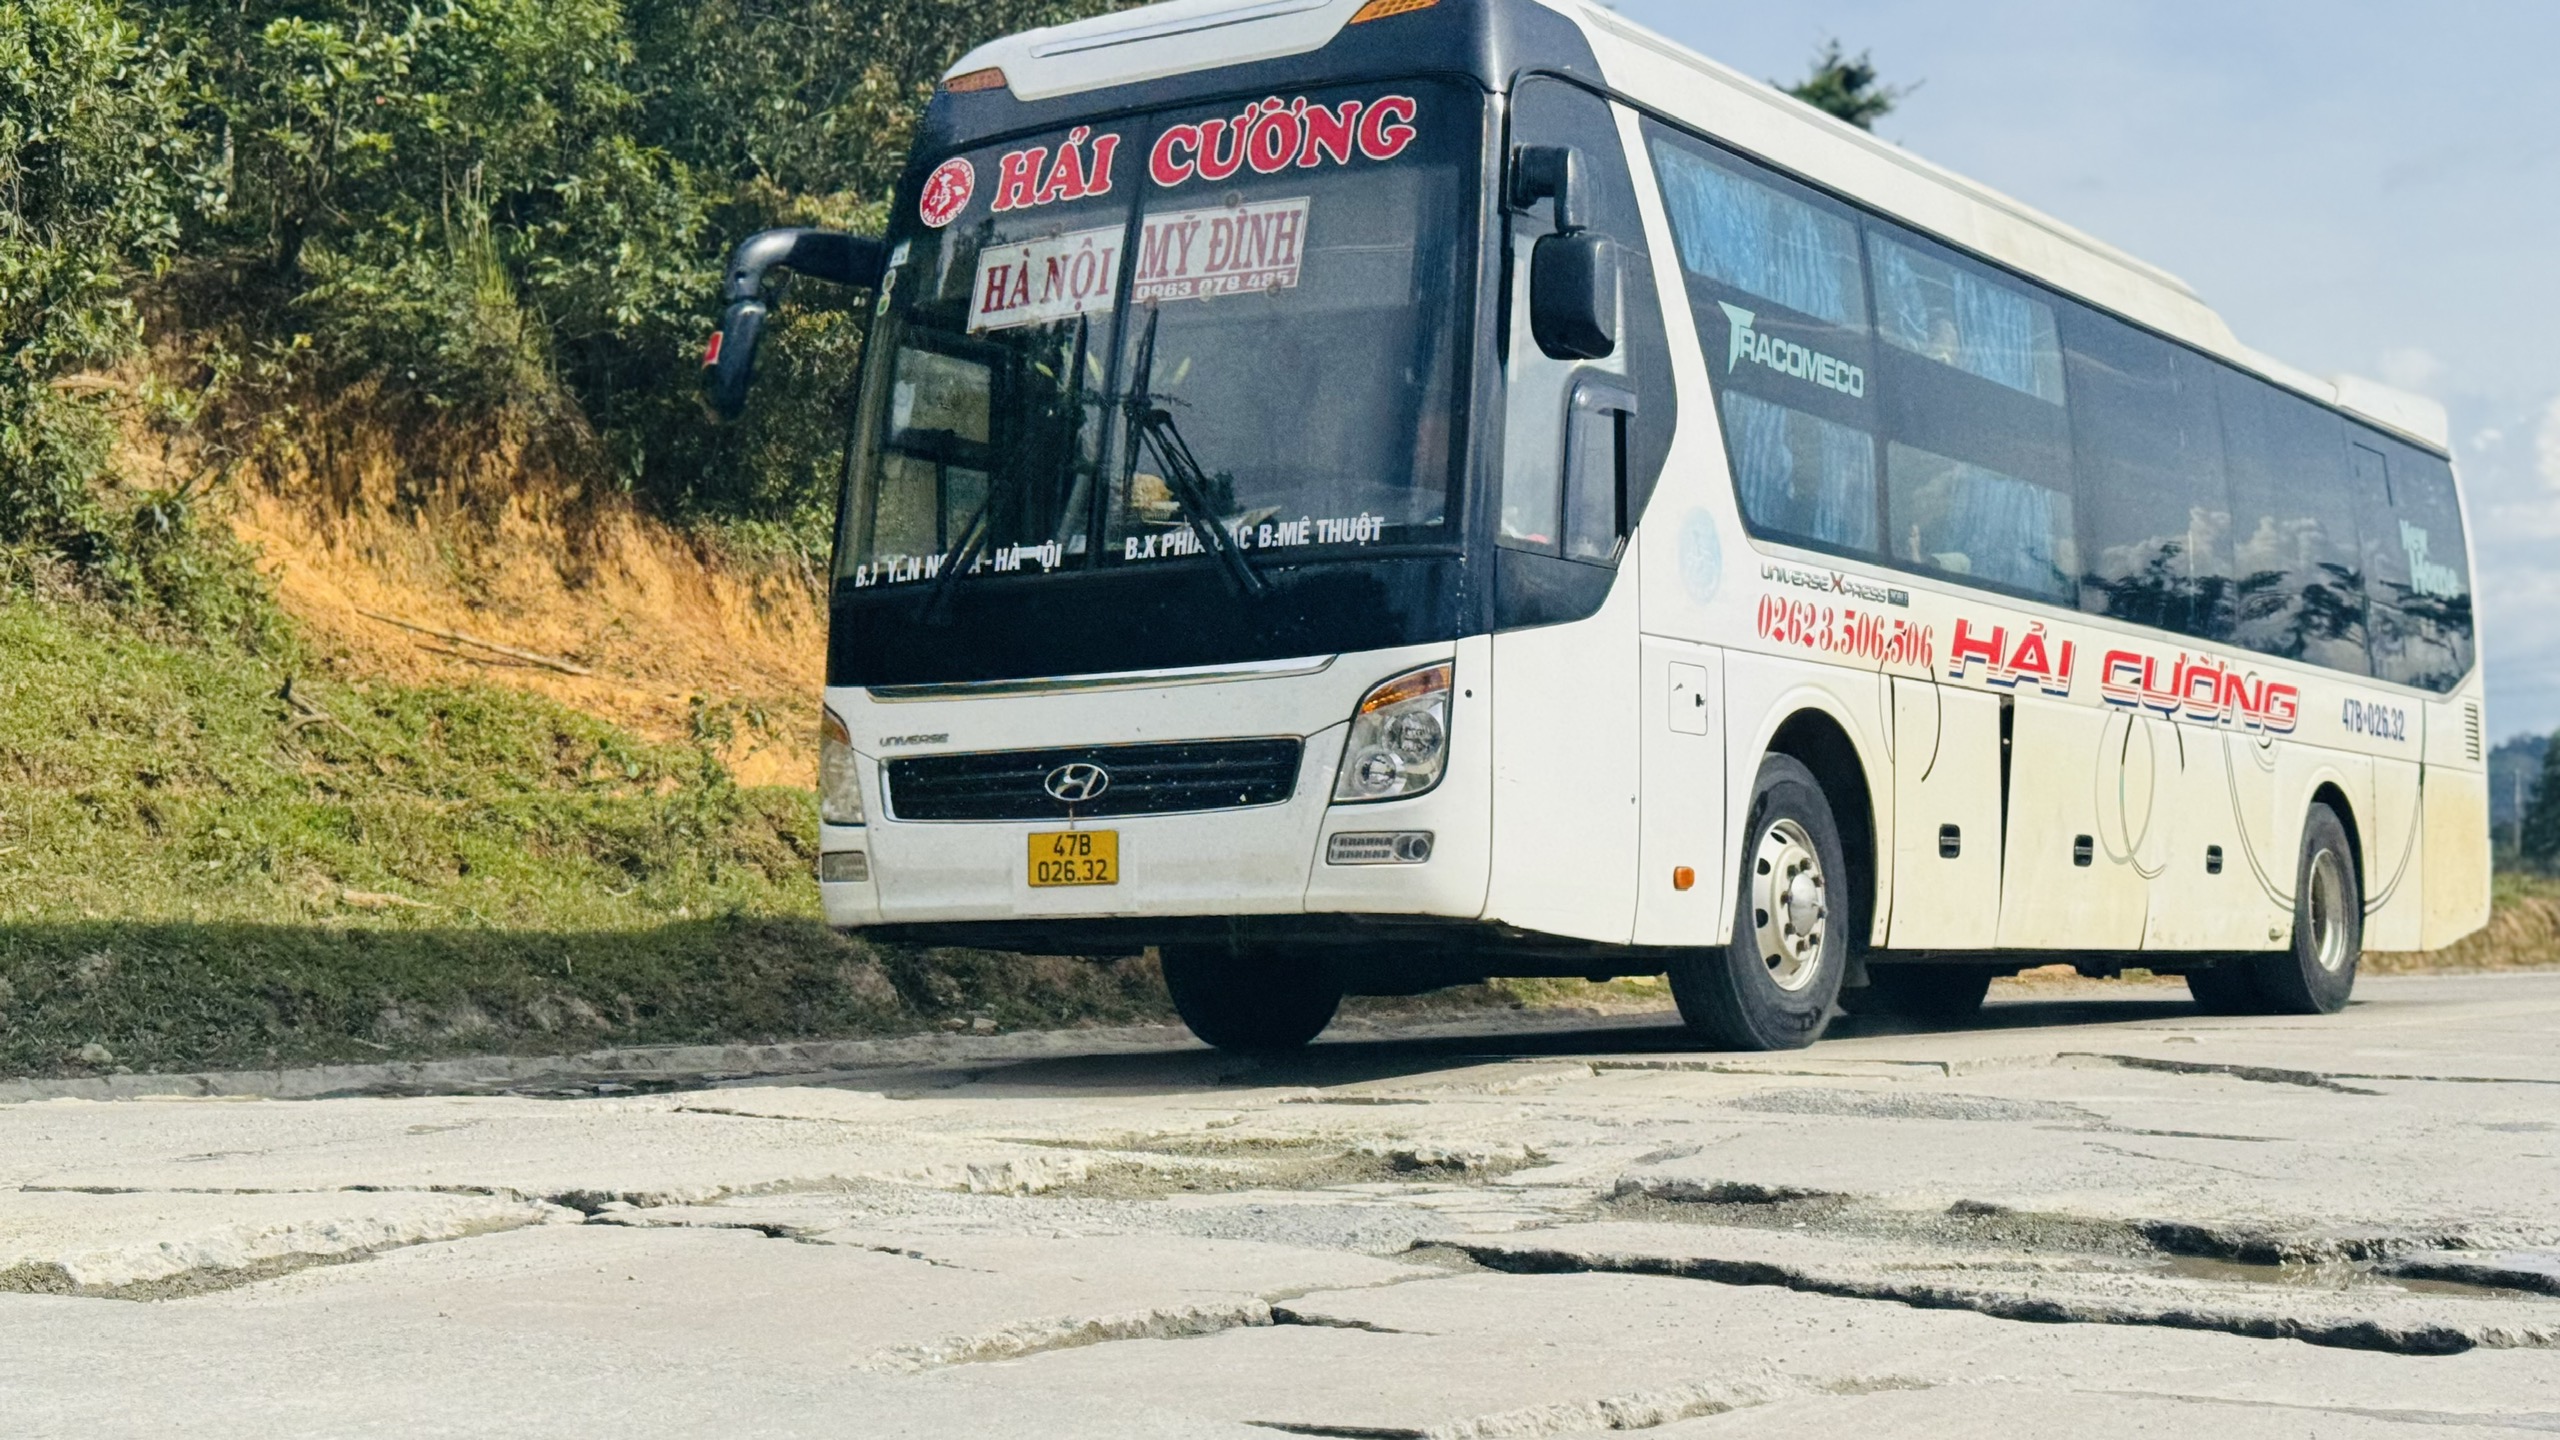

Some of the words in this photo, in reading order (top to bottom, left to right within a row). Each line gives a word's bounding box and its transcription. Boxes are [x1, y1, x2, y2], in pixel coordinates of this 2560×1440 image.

[991, 126, 1120, 214] HẢI
[1149, 95, 1417, 188] CƯỜNG
[981, 248, 1030, 313] HÀ
[1039, 237, 1114, 310] NỘI
[1137, 214, 1201, 279] MỸ
[1204, 208, 1302, 273] ĐÌNH
[1718, 300, 1864, 398] TRACOMECO
[1125, 535, 1157, 560] B.X
[1317, 511, 1384, 547] THUỘT
[1949, 617, 2076, 698] HẢI
[2101, 649, 2300, 734] CƯỜNG
[1038, 859, 1107, 882] 026.32
[1053, 834, 1091, 857] 47B
